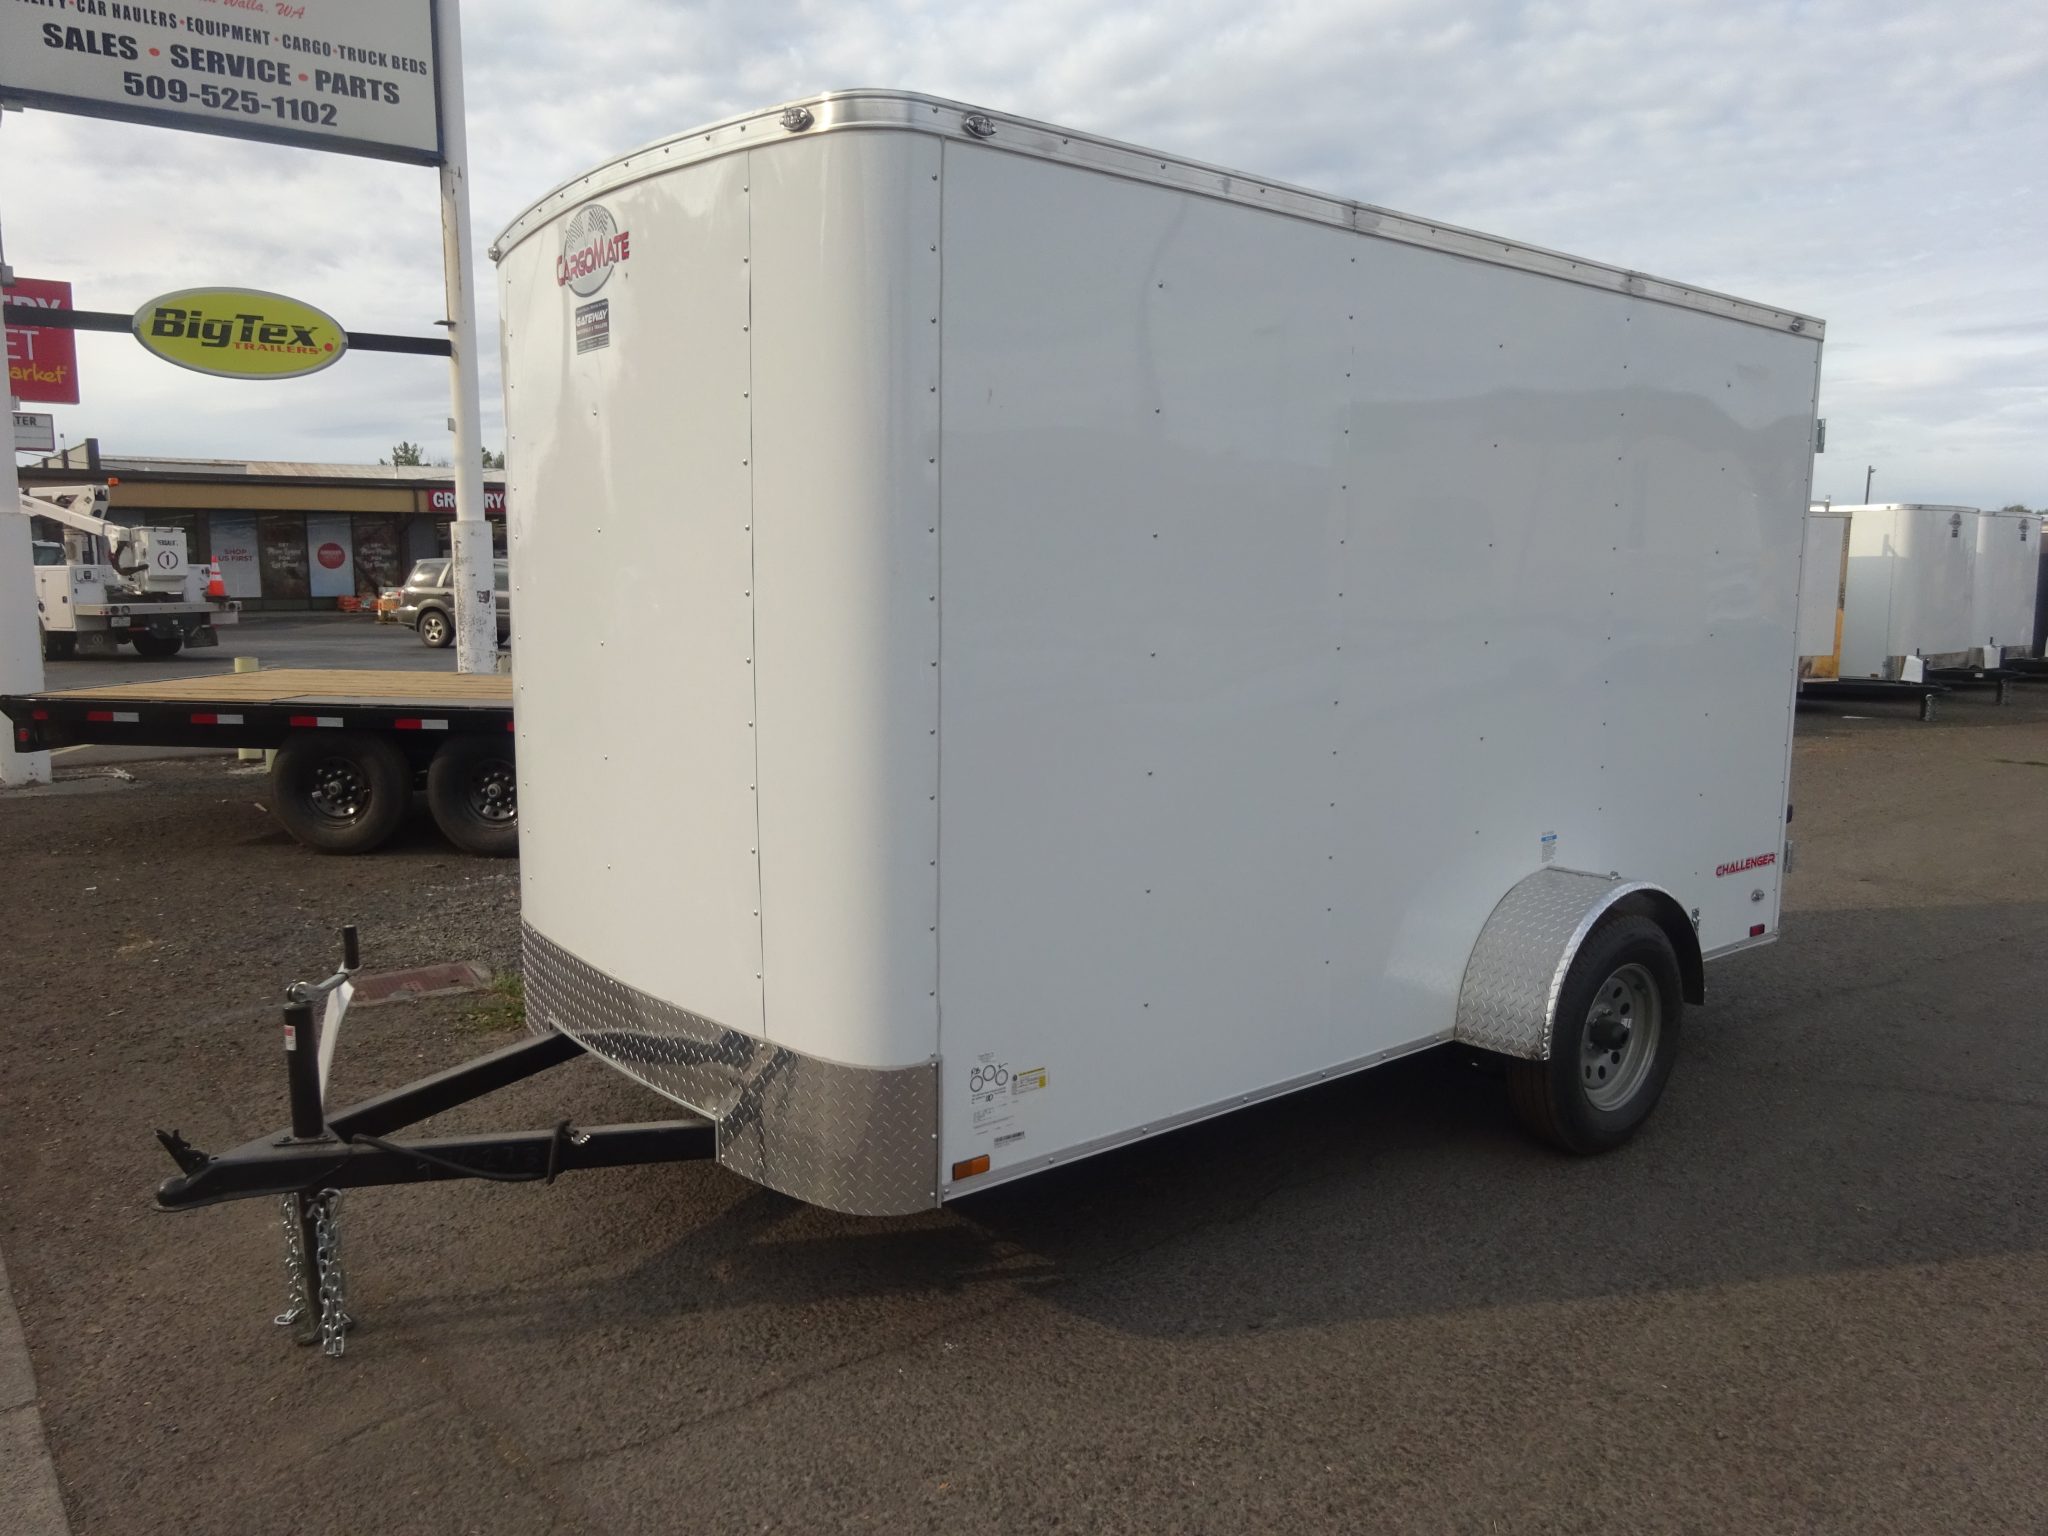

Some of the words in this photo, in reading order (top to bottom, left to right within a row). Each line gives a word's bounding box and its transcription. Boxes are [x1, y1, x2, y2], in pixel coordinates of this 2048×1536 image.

[275, 3, 305, 19] WA
[76, 0, 107, 17] CAR
[112, 3, 177, 29] HAULERS
[186, 16, 270, 46] EQUIPMENT
[282, 34, 331, 57] CARGO
[338, 44, 388, 68] TRUCK
[391, 55, 427, 76] BEDS
[42, 22, 139, 60] SALES
[170, 44, 292, 86] SERVICE
[315, 69, 400, 105] PARTS
[123, 71, 338, 126] 509-525-1102
[233, 341, 320, 355] TRAILERS
[10, 362, 67, 385] arket
[1715, 852, 1776, 877] CHALLENGER
